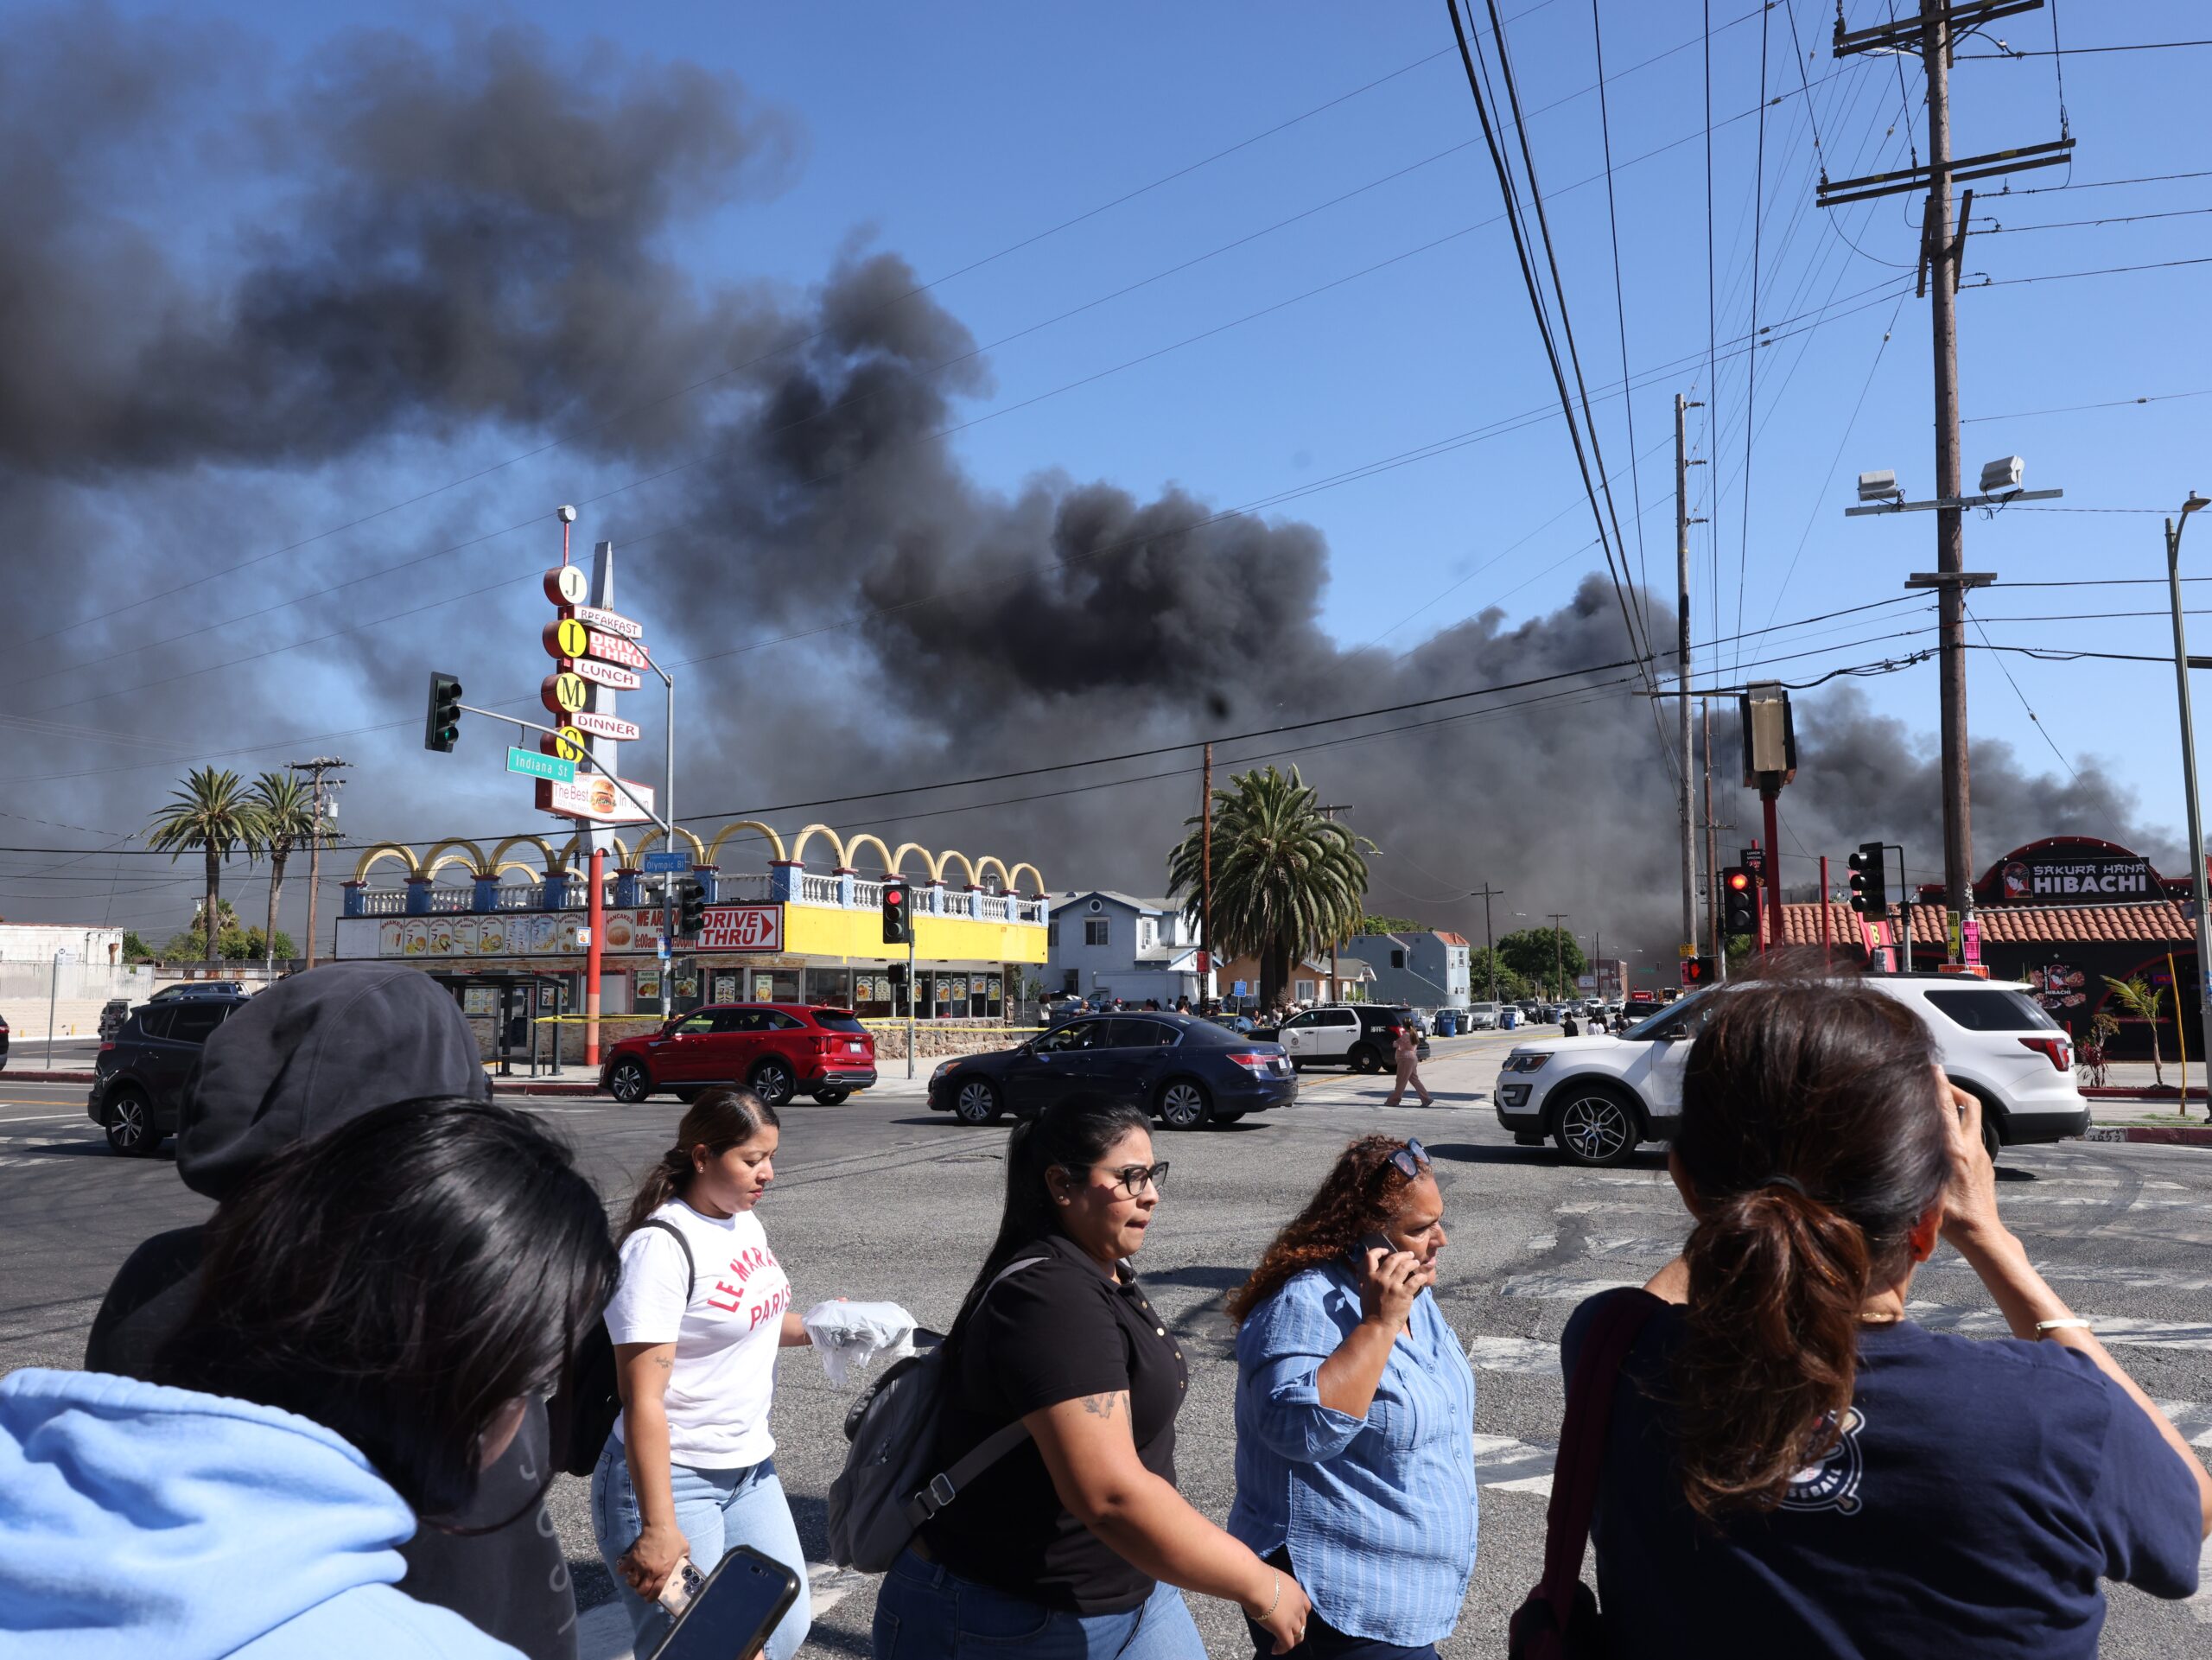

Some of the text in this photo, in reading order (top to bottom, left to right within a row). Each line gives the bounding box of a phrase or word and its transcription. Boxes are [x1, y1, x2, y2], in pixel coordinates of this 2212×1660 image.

[591, 633, 648, 657] DRIVE
[593, 645, 645, 667] THRU
[581, 663, 633, 684] LUNCH
[578, 716, 635, 735] DINNER
[516, 755, 568, 777] Indiana St
[553, 782, 569, 799] The
[570, 785, 589, 803] Best
[620, 793, 626, 808] In
[646, 861, 674, 871] Olympic
[2033, 864, 2146, 875] SAKURA HANA
[2034, 875, 2146, 894] HIBACHI
[607, 913, 633, 925] PANCAKES
[636, 910, 650, 927] WE
[651, 910, 664, 926] AR
[702, 912, 760, 928] DRIVE
[635, 933, 658, 949] 6:00am
[702, 929, 756, 945] THRU
[1869, 924, 1880, 944] B
[707, 1280, 745, 1313] LE
[749, 1283, 791, 1332] PARIS
[1788, 1469, 1842, 1499] SEBALL
